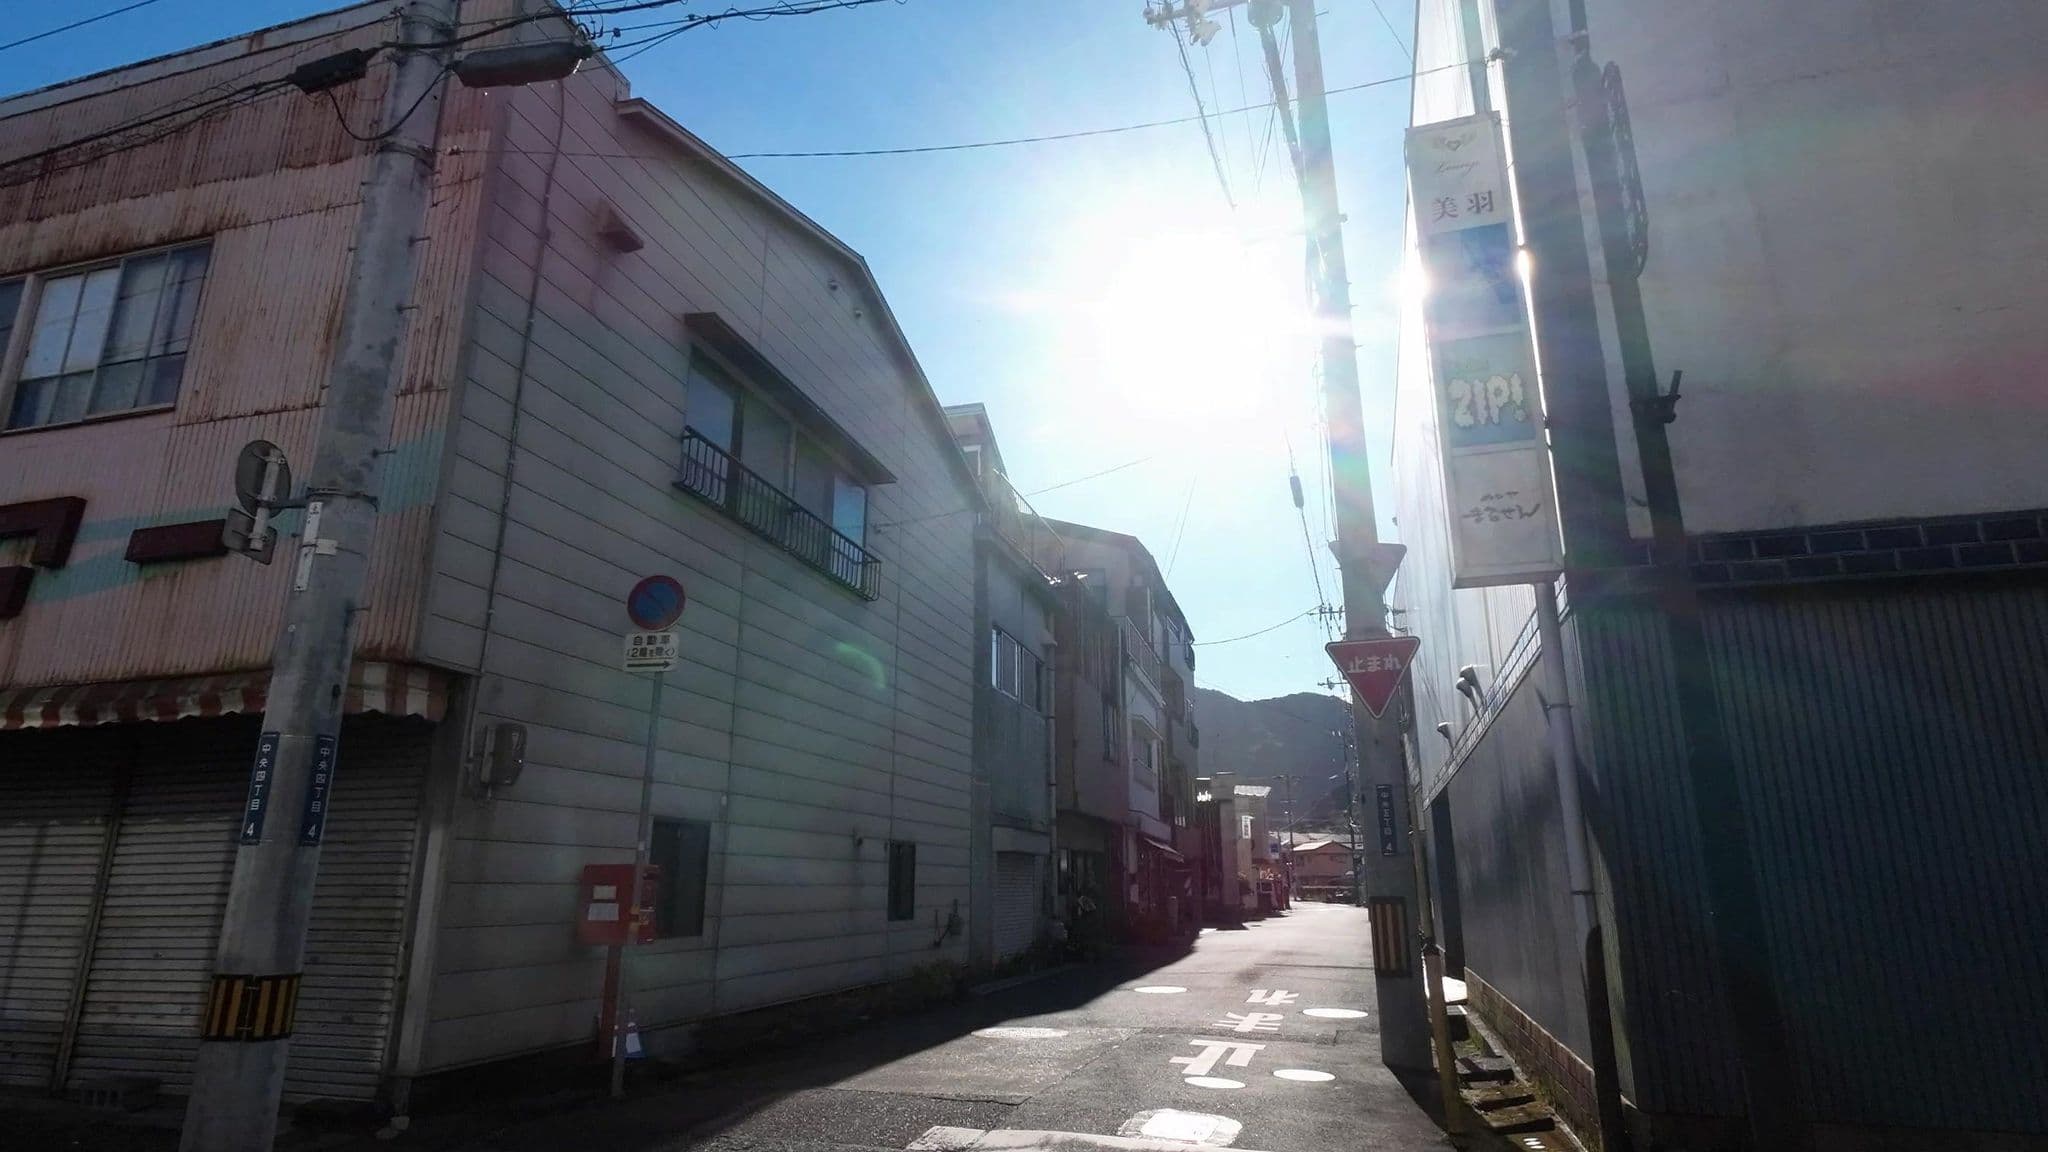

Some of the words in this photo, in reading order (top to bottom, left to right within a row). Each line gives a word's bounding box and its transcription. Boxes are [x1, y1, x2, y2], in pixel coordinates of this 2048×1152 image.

[1432, 189, 1494, 223] 美羽
[1446, 372, 1528, 428] ZIP!
[1347, 652, 1403, 674] 止まれ
[250, 743, 272, 811] 中央四丁目
[311, 747, 331, 813] 中央四丁目
[246, 822, 255, 837] 4
[307, 824, 317, 838] 4
